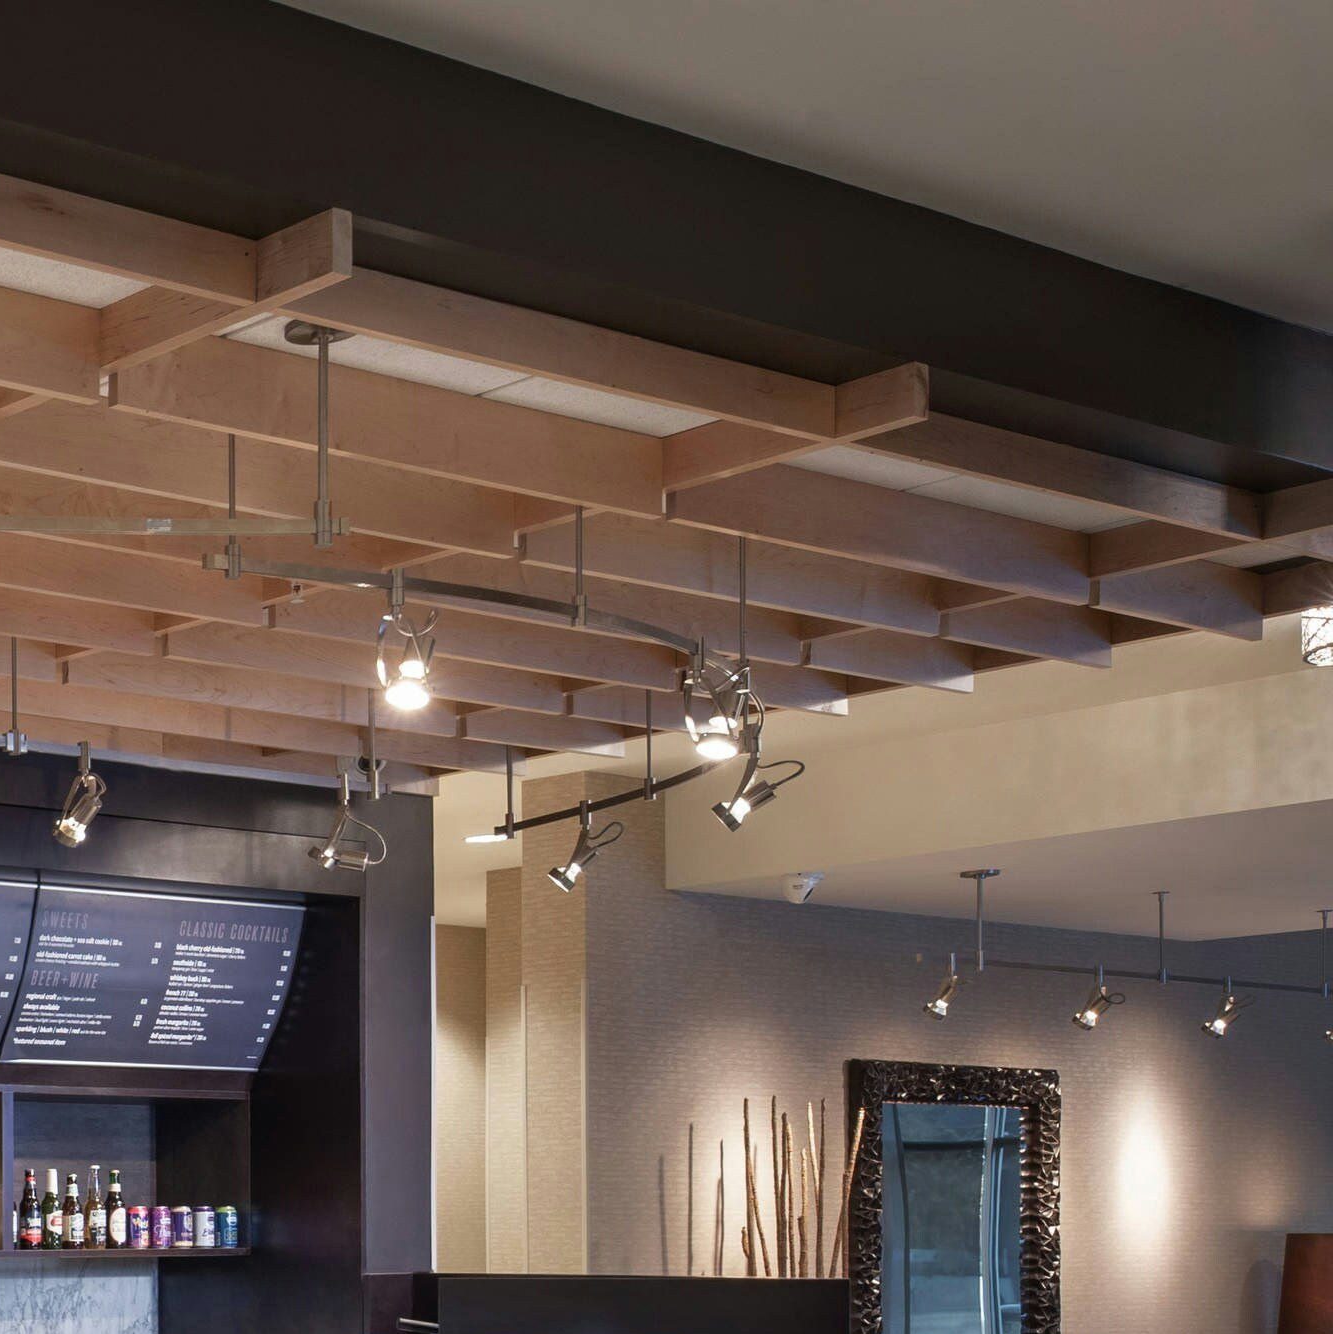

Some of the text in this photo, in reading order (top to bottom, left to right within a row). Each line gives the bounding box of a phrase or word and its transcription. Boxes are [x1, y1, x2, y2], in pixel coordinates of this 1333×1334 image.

[42, 911, 89, 929] SWEETS
[180, 920, 289, 943] CLASSIC COCKTAILS
